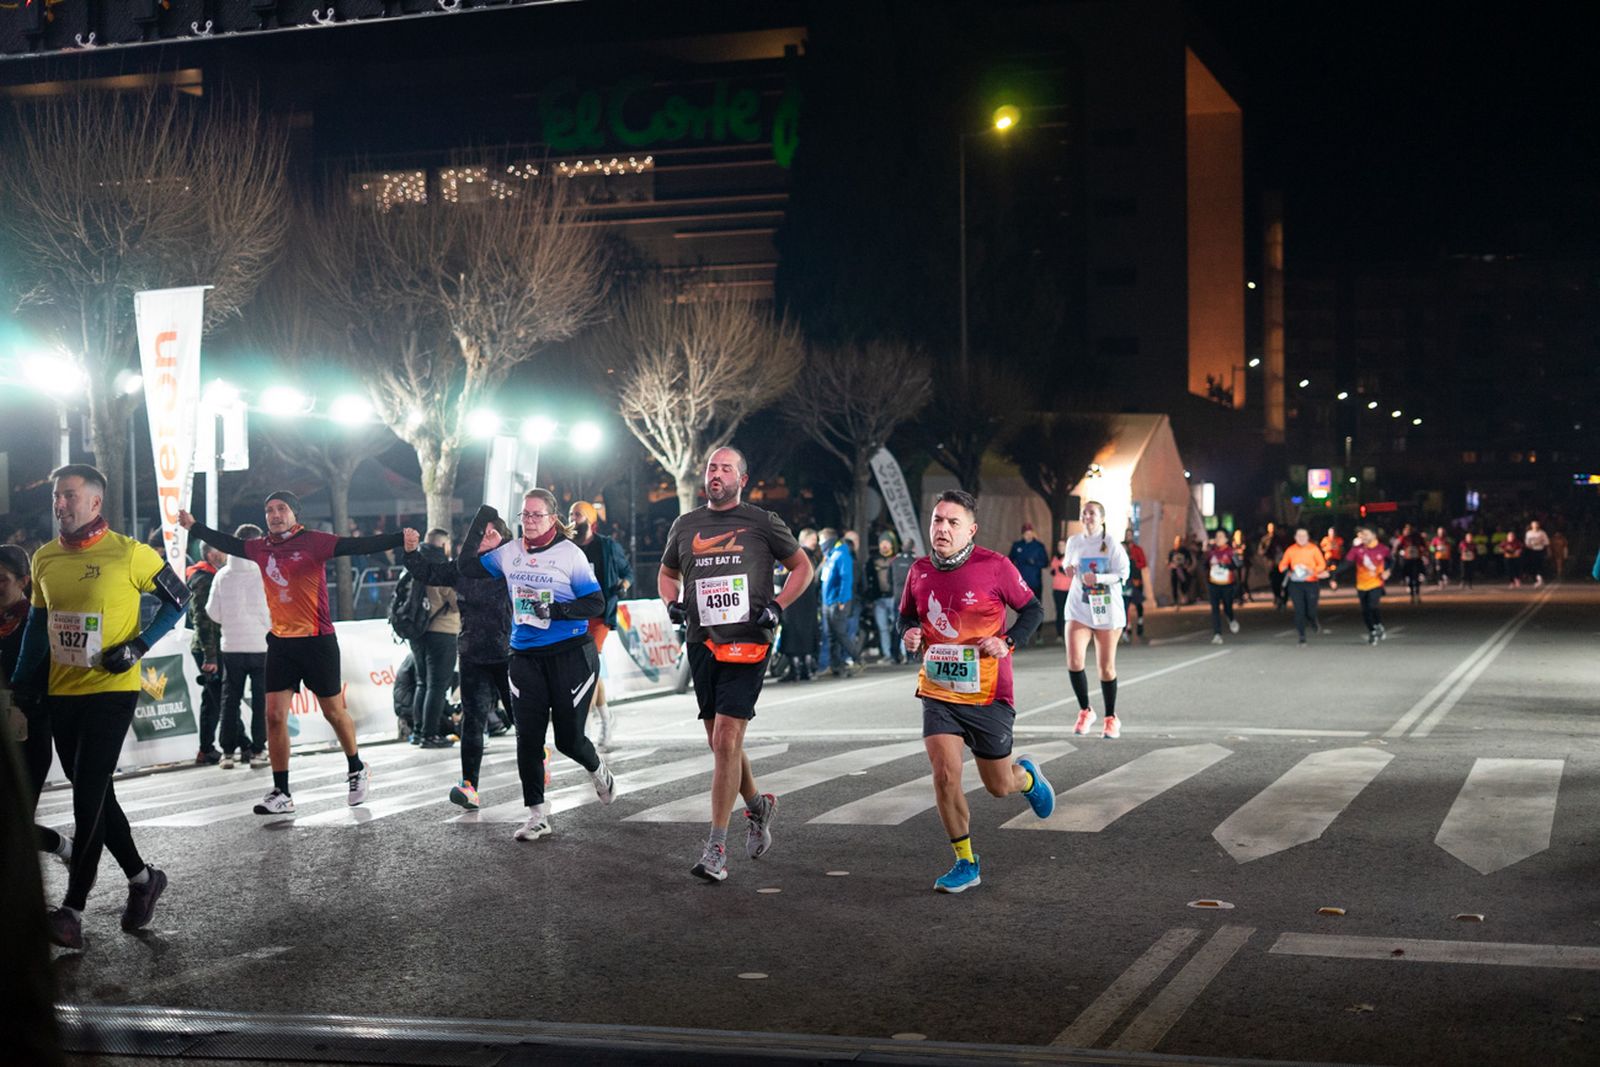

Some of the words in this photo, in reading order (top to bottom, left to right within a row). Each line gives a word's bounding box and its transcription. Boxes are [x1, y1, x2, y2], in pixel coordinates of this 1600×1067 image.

[539, 86, 604, 149] El
[608, 78, 762, 145] Corte
[695, 557, 713, 567] JUST
[715, 556, 730, 566] EAT
[732, 555, 742, 565] IT.
[509, 572, 553, 584] MARACENA
[706, 592, 740, 609] 4306
[58, 631, 89, 648] 1327
[640, 622, 663, 643] SAN
[935, 662, 968, 677] 7425
[134, 704, 156, 719] CAJA
[157, 701, 187, 715] RURAL
